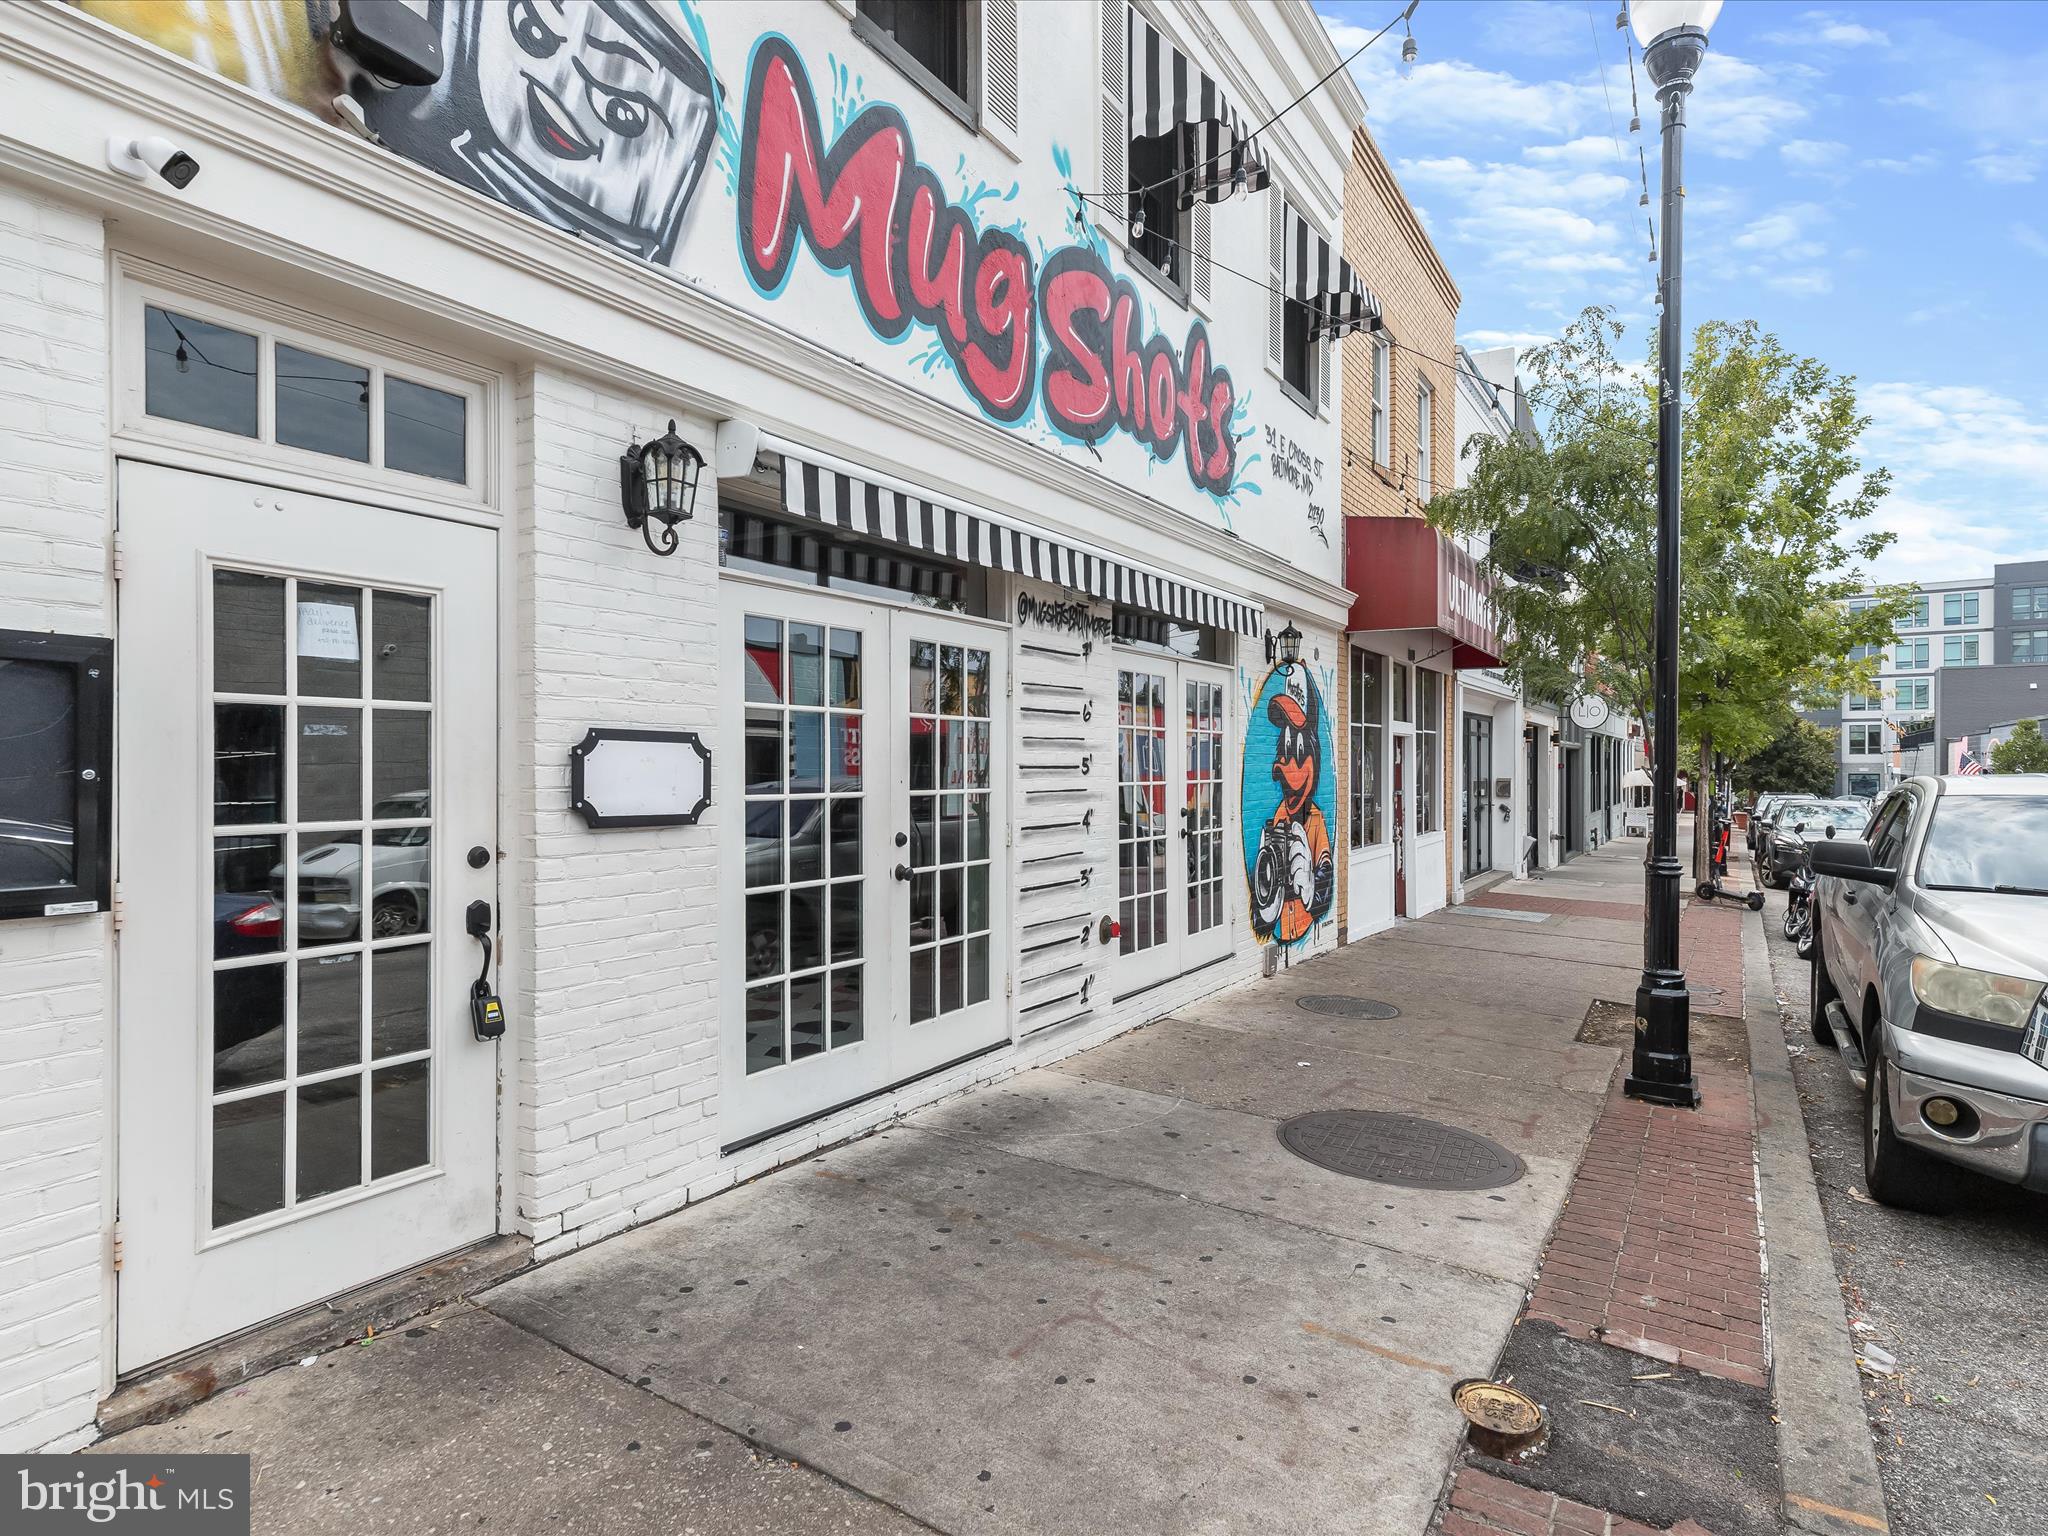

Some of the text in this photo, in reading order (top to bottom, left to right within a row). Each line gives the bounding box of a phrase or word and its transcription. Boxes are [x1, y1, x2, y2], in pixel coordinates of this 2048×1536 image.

[740, 36, 1236, 497] Mug Shots
[1265, 423, 1277, 449] 31
[1280, 434, 1286, 453] E
[1289, 440, 1311, 473] CROSS
